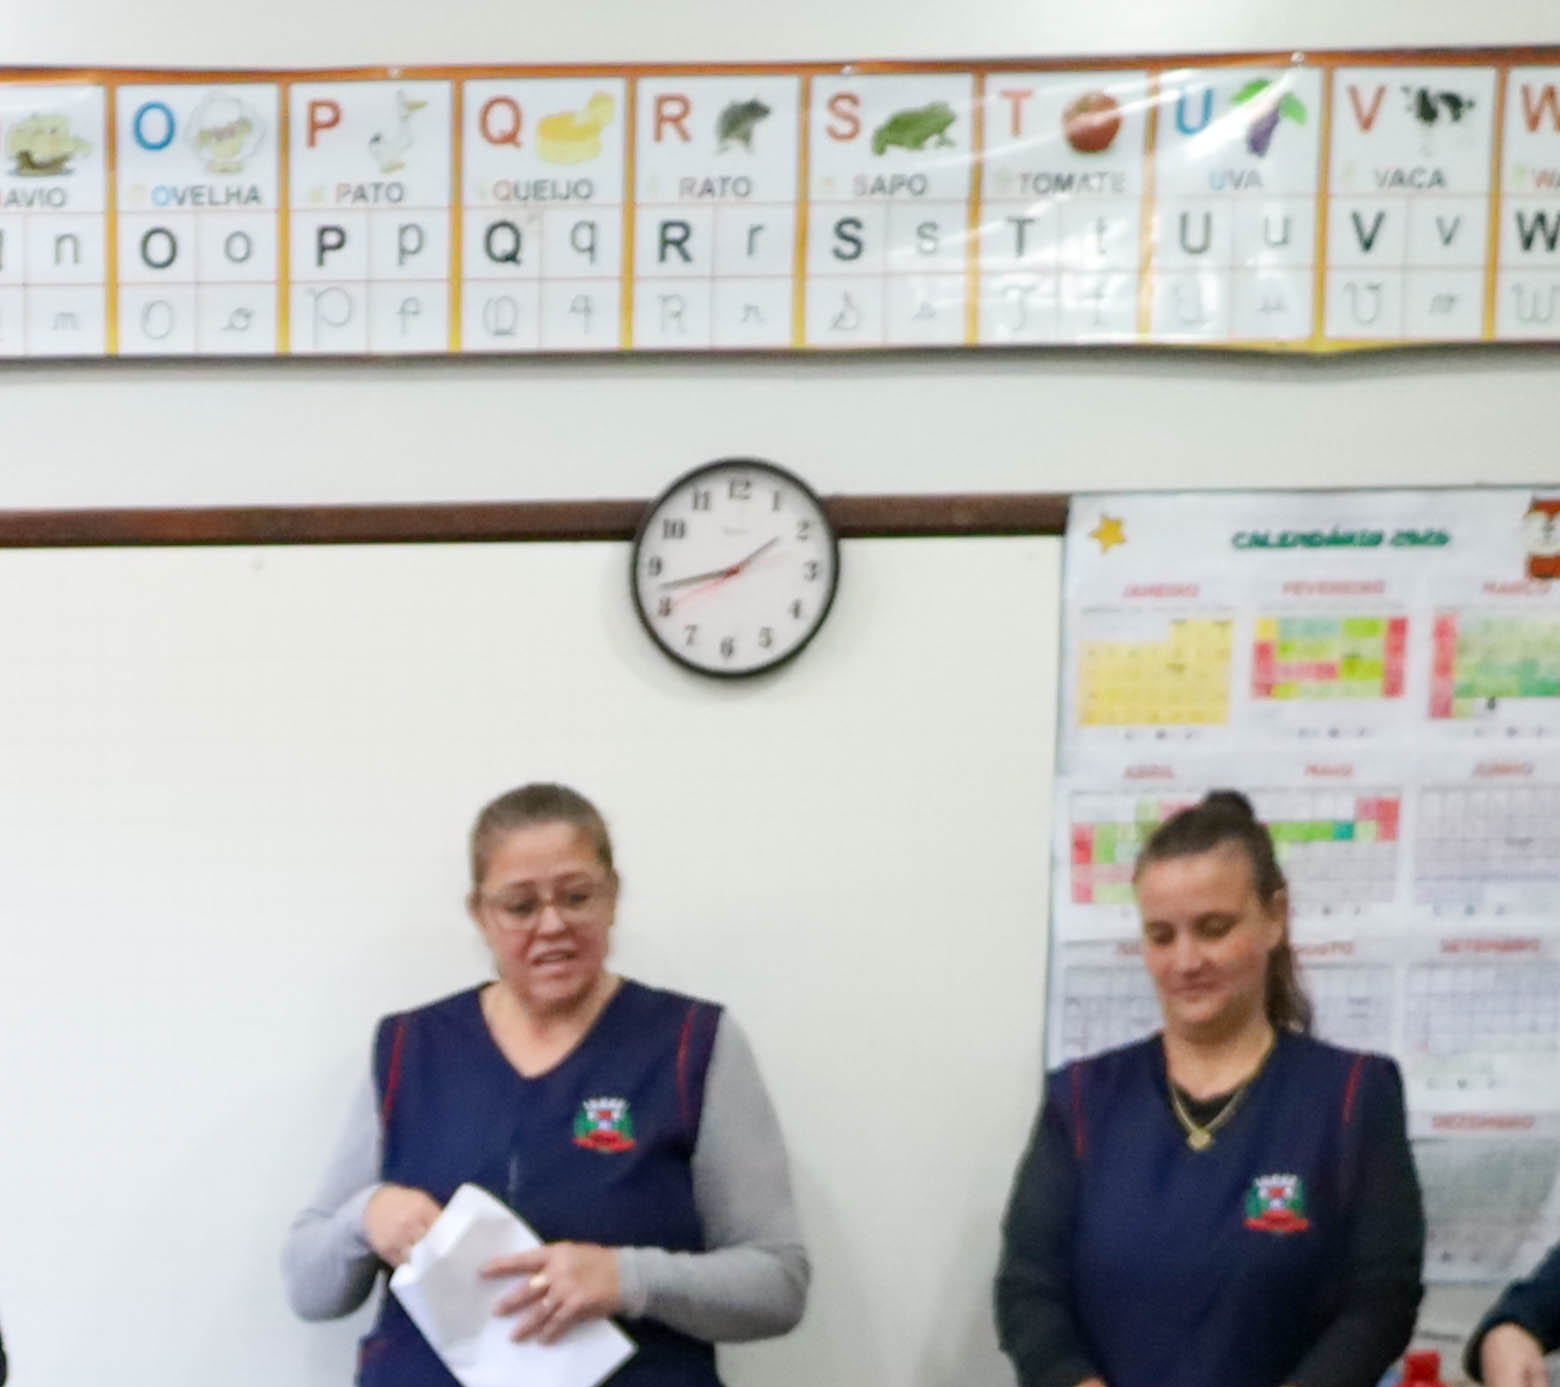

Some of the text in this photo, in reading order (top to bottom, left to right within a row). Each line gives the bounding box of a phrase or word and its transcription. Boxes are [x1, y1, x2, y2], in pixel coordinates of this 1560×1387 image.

[134, 102, 176, 150] O
[307, 101, 341, 147] P
[480, 97, 523, 149] Q
[654, 95, 692, 142] R
[827, 94, 861, 140] S
[1001, 91, 1031, 136] T
[1175, 89, 1213, 136] U
[1348, 86, 1387, 132] V
[151, 185, 261, 207] OVELHA
[337, 183, 404, 204] PATO
[494, 178, 593, 200] QUEIJO
[680, 177, 752, 198] RATO
[54, 234, 79, 264] n
[141, 228, 252, 269] O o
[317, 225, 423, 266] P p
[484, 222, 596, 264] Q q
[661, 222, 692, 263] R
[833, 218, 864, 260] S
[1009, 219, 1034, 258] T
[1182, 212, 1211, 254] U
[1351, 211, 1461, 252] V v
[729, 479, 751, 500] 12
